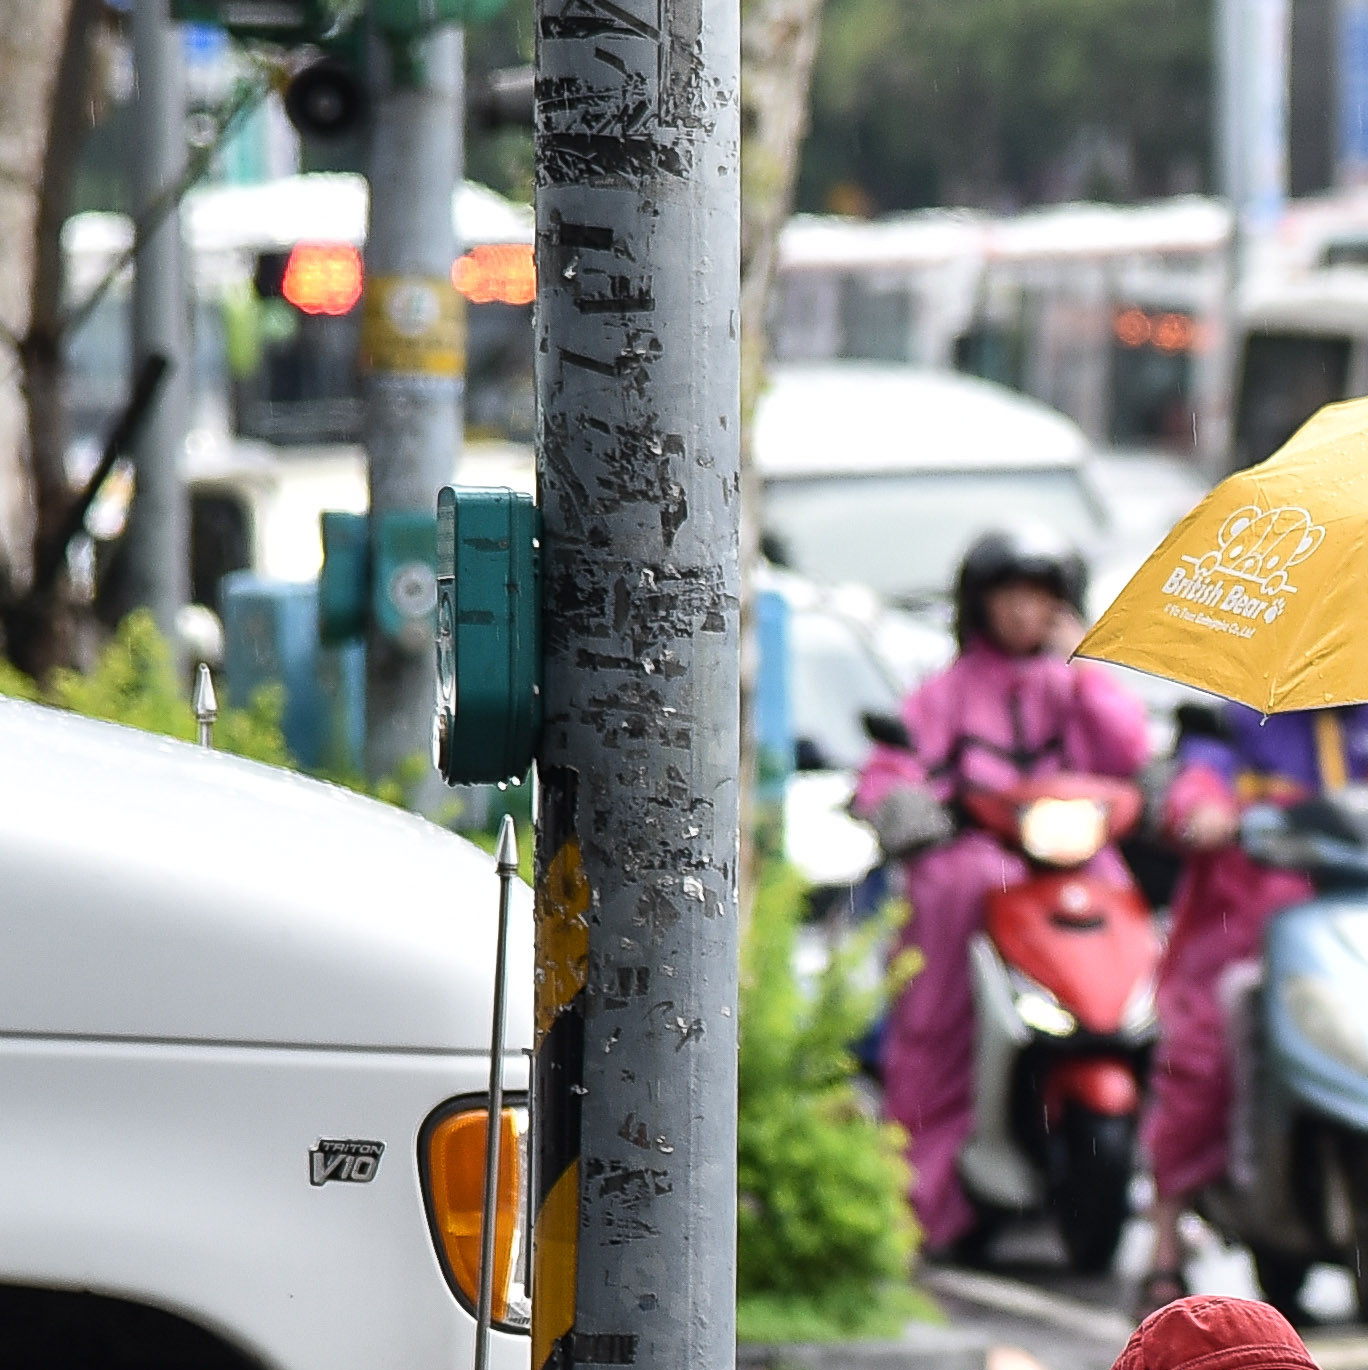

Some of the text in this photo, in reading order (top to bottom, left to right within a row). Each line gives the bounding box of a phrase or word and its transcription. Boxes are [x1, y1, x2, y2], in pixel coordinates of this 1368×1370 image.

[1162, 566, 1223, 607] British
[1219, 584, 1268, 619] Bear
[323, 1142, 383, 1153] TRITON
[313, 1152, 376, 1183] V10
